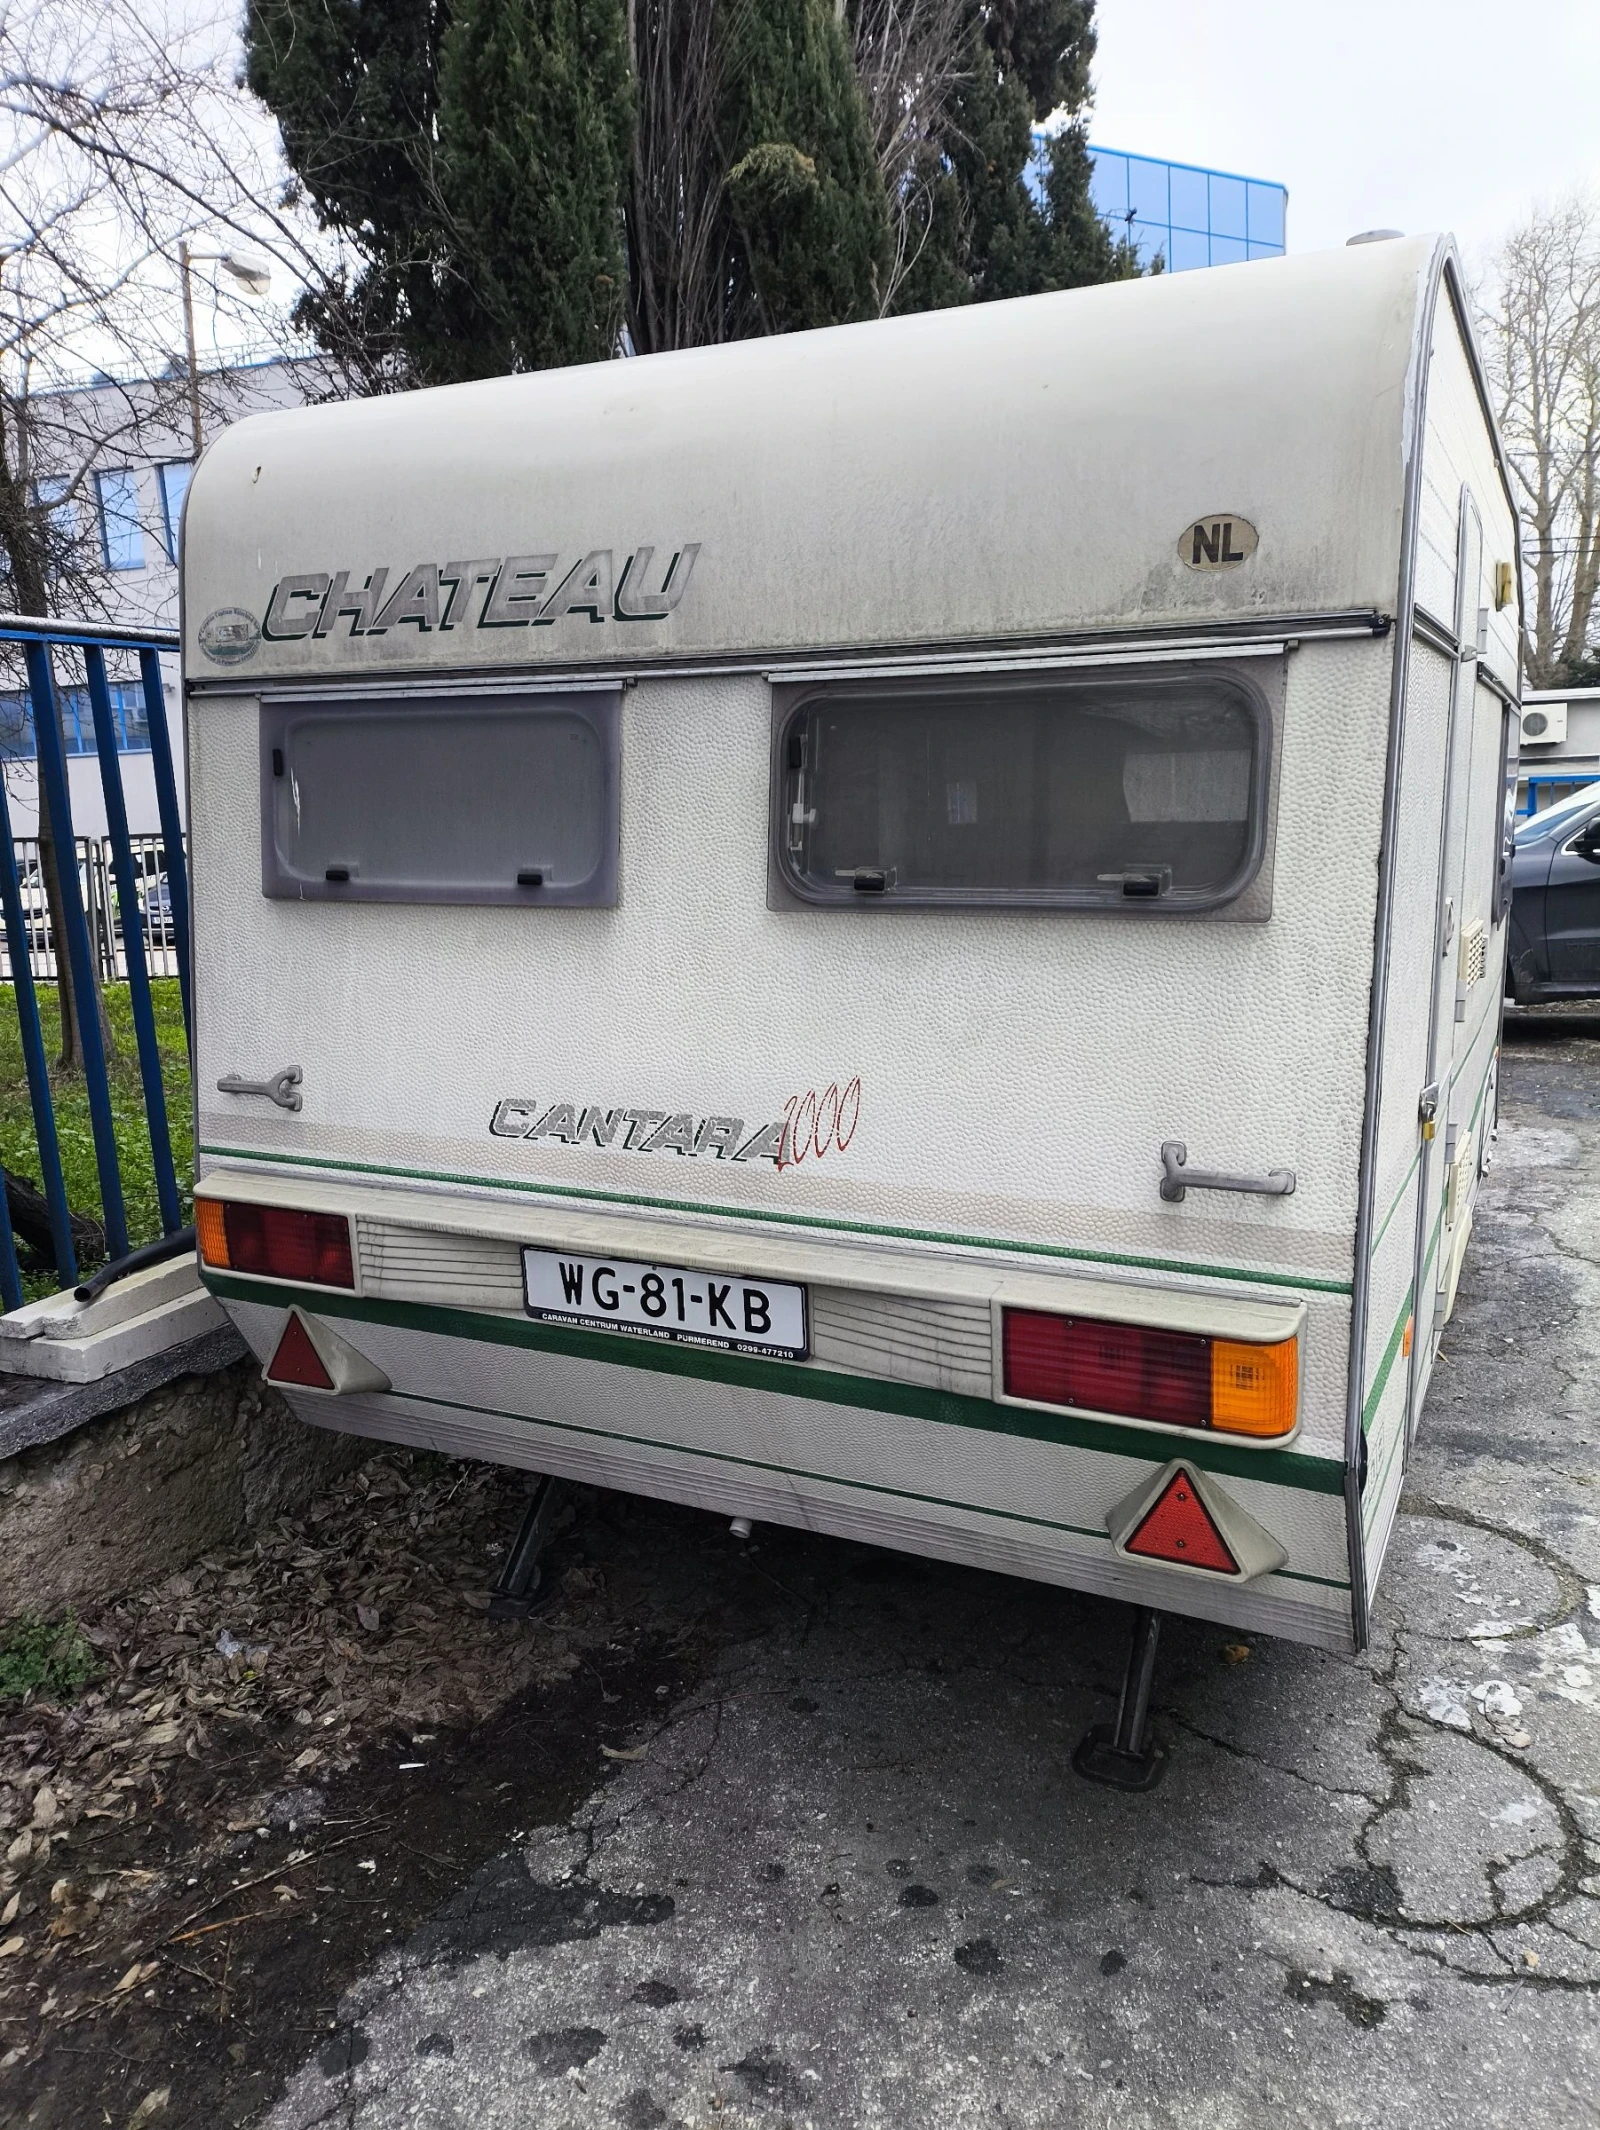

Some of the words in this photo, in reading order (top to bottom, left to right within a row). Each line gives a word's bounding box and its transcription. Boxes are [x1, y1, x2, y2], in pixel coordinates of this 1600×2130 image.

[1192, 523, 1243, 564] NL
[262, 543, 701, 641] CHATEAU
[489, 1099, 791, 1165] CANTARA
[541, 1313, 578, 1325] CARAVAN
[579, 1318, 618, 1331] CENTRUM
[620, 1324, 670, 1339] WATERLAND
[677, 1333, 729, 1349] PURMEREND
[559, 1262, 771, 1334] WG-81-KB
